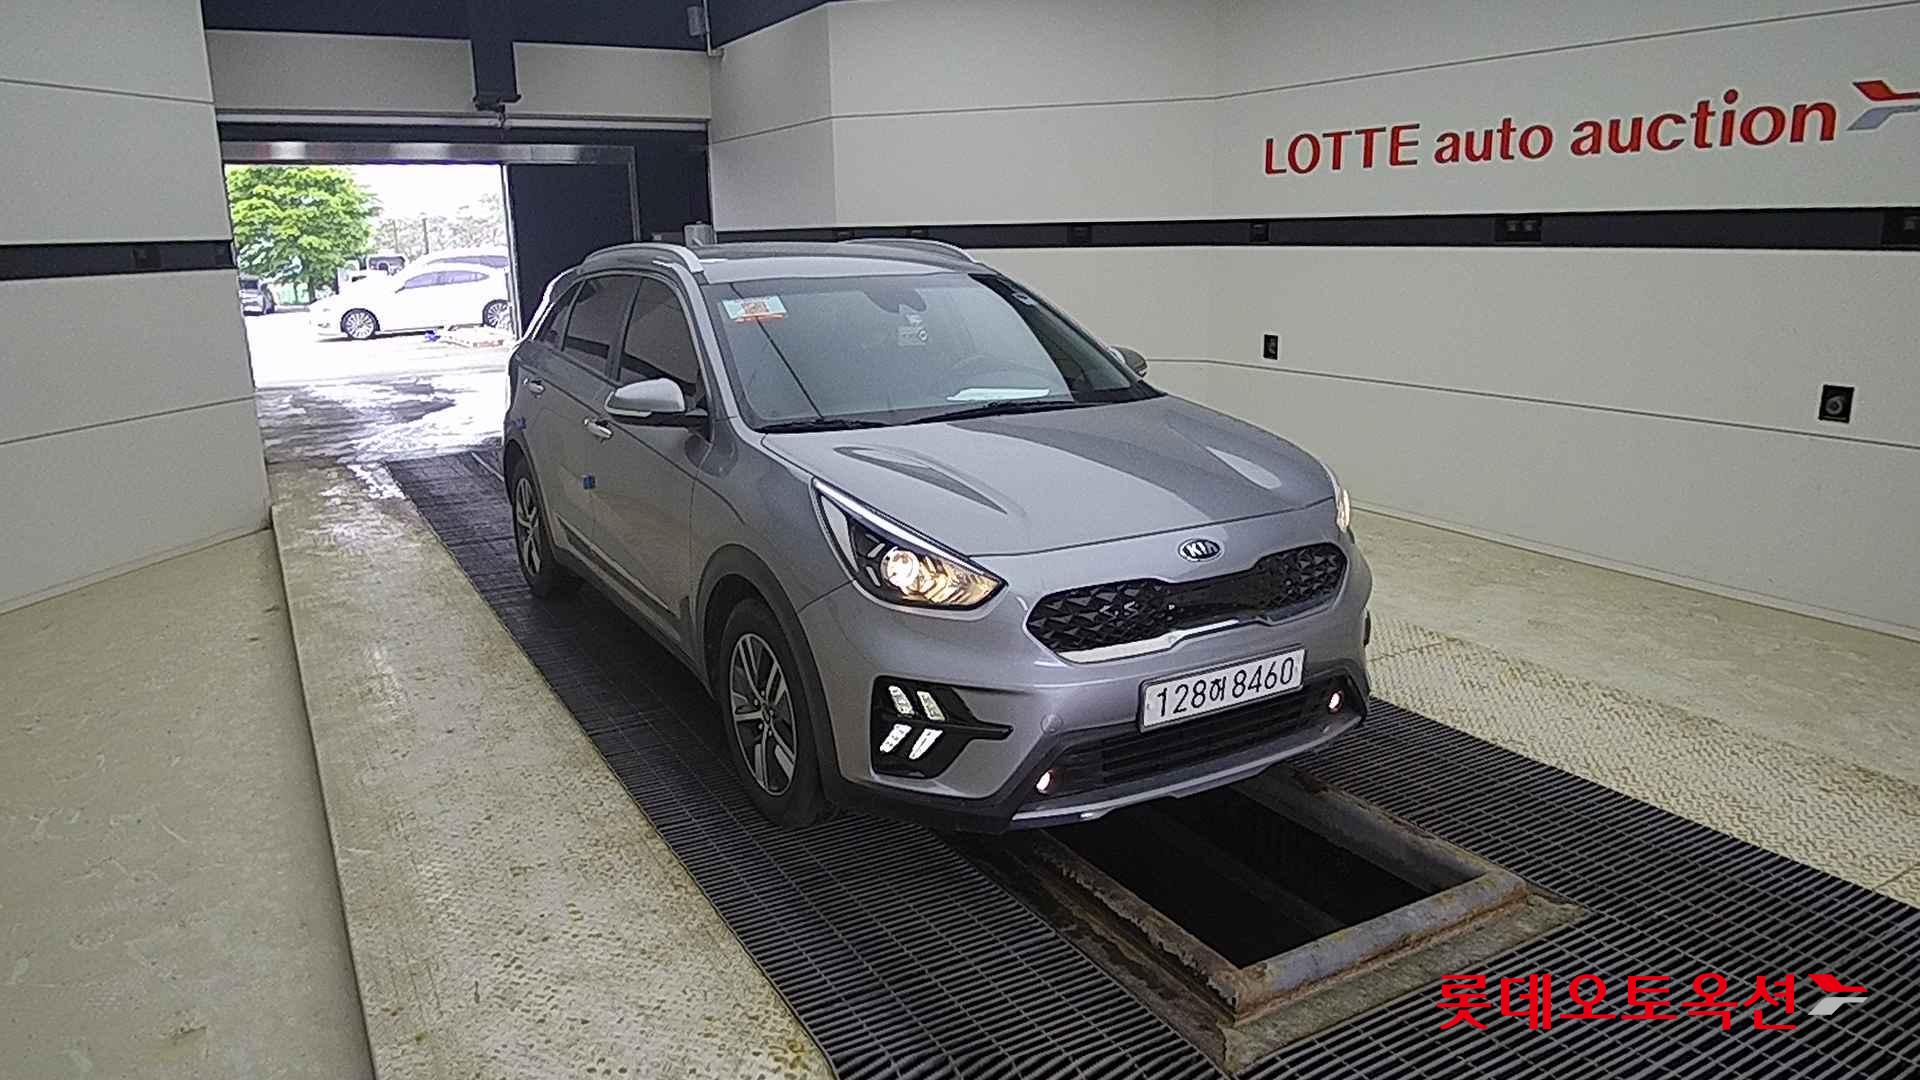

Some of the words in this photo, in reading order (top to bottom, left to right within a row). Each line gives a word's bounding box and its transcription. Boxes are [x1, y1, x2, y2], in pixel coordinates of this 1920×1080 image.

[1265, 123, 1420, 175] LOTTE
[1434, 117, 1554, 164] auto
[1571, 89, 1837, 157] auction
[1186, 541, 1219, 557] KIA
